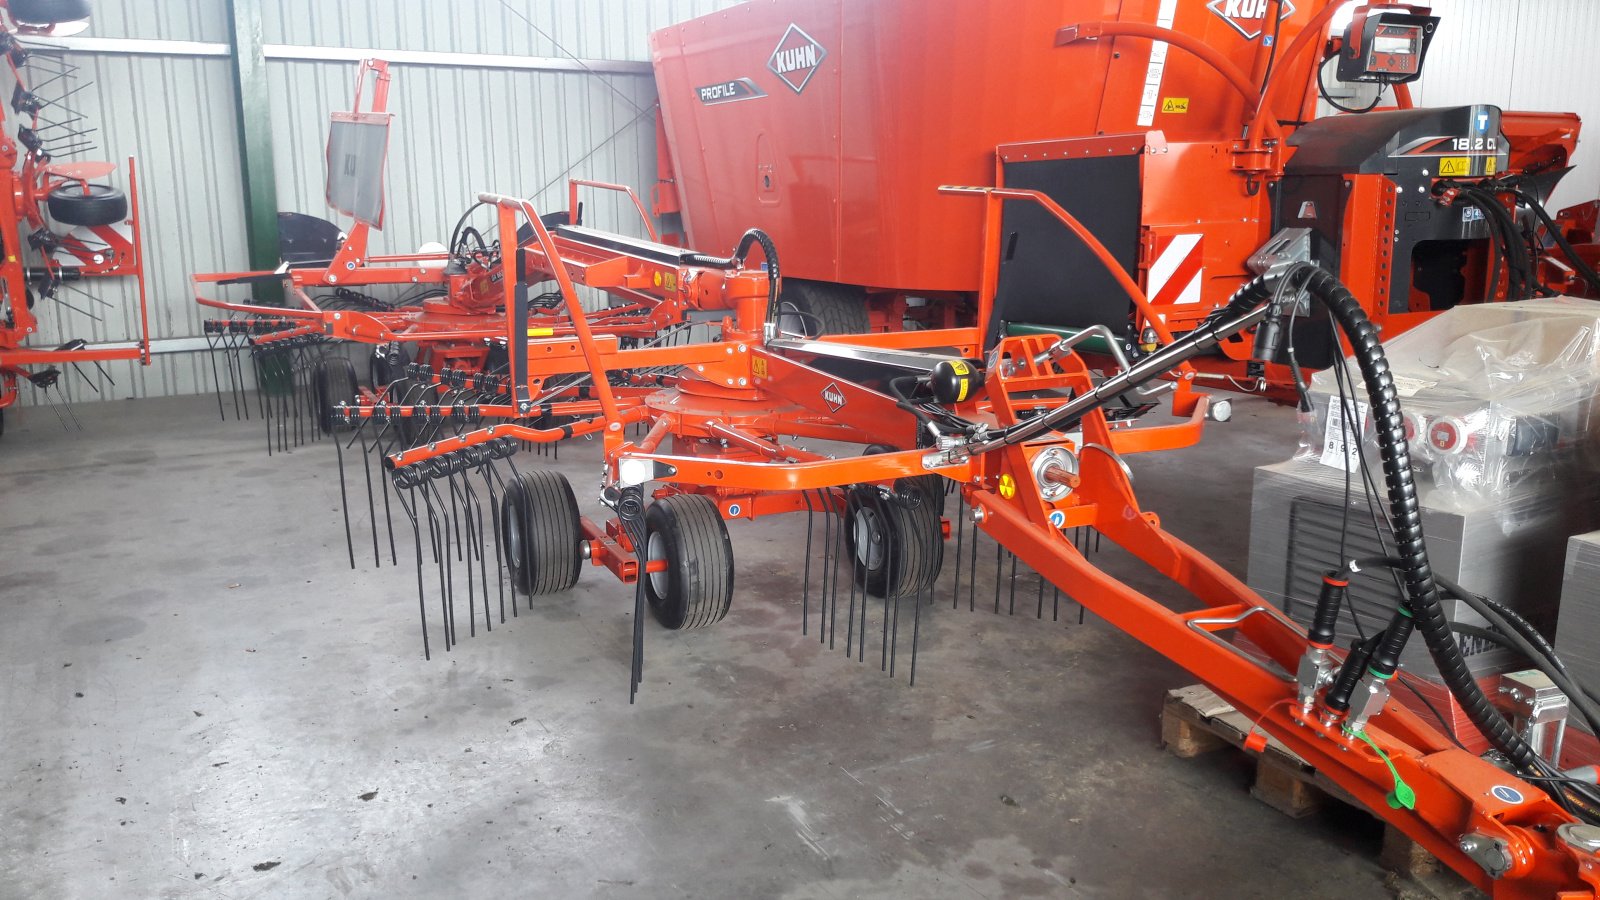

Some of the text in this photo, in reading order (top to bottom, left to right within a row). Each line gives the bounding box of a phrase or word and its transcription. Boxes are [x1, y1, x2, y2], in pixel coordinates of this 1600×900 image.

[1224, 0, 1285, 19] KUH
[776, 44, 816, 73] KUHN
[701, 82, 736, 100] PROFILE
[1452, 137, 1484, 150] 18.2
[824, 390, 843, 406] KUHN
